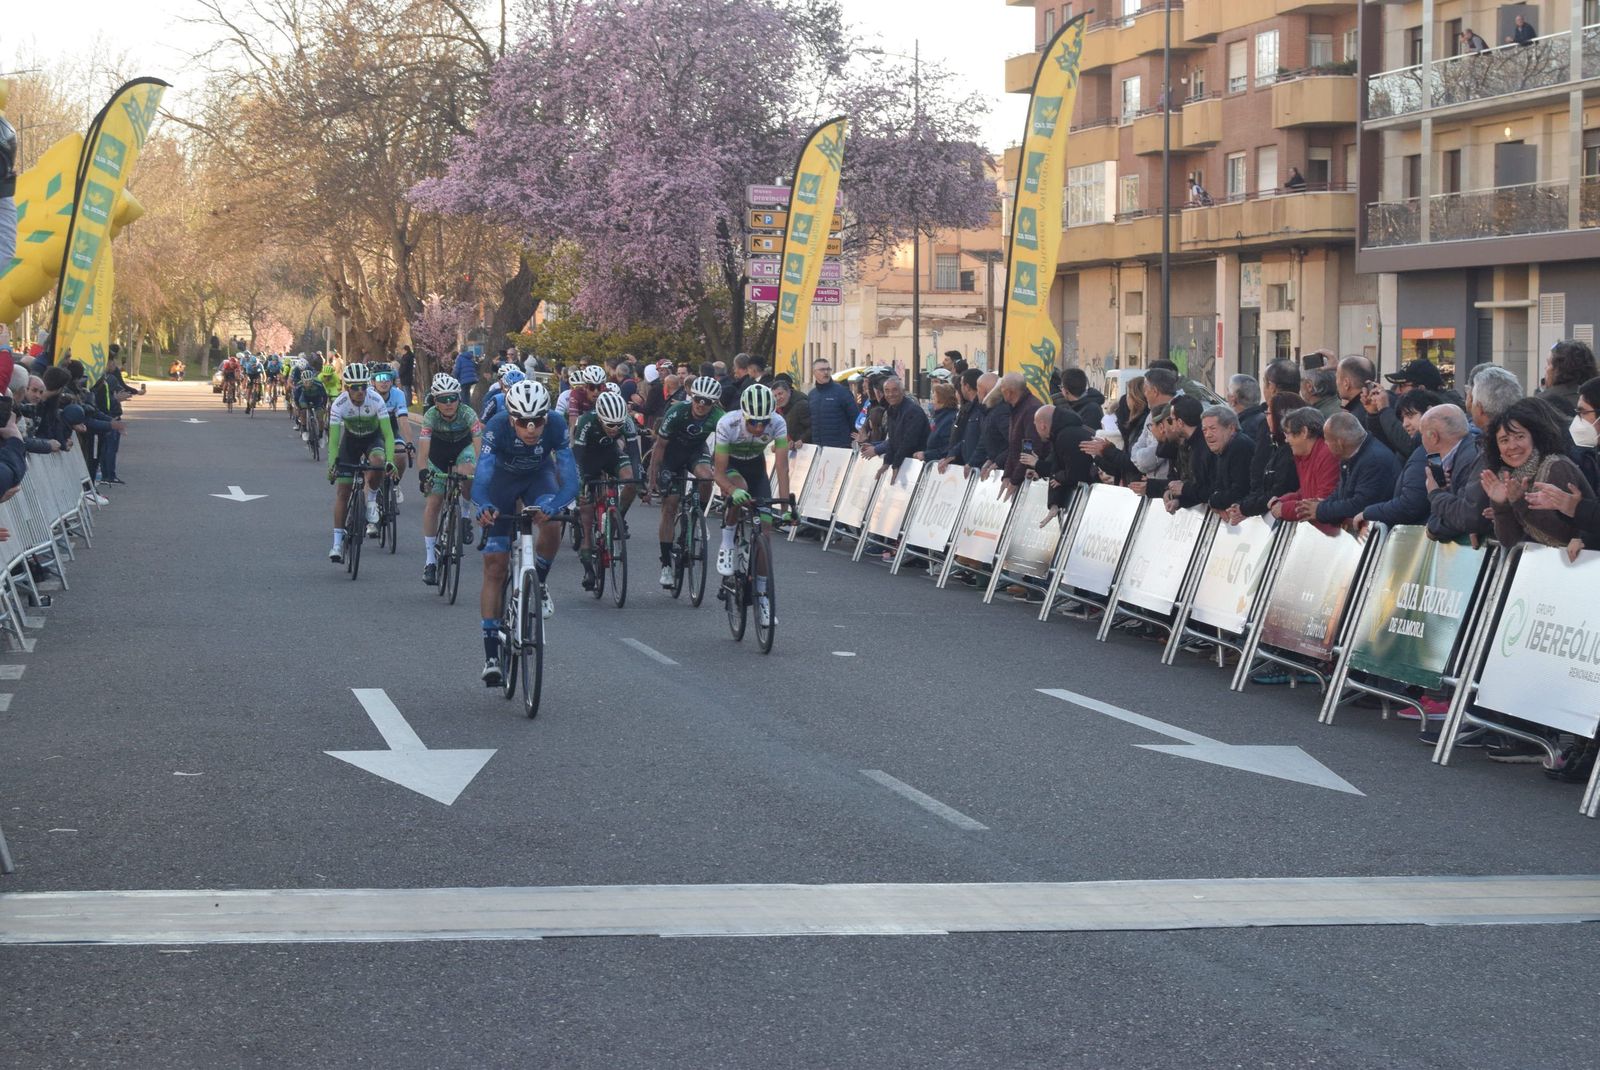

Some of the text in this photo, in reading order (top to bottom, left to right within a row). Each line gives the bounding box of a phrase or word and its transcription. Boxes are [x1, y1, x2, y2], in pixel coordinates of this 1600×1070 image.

[1397, 582, 1464, 620] CAJA RURAL
[1536, 603, 1557, 617] GRUPO
[1396, 618, 1425, 639] ZAMORA
